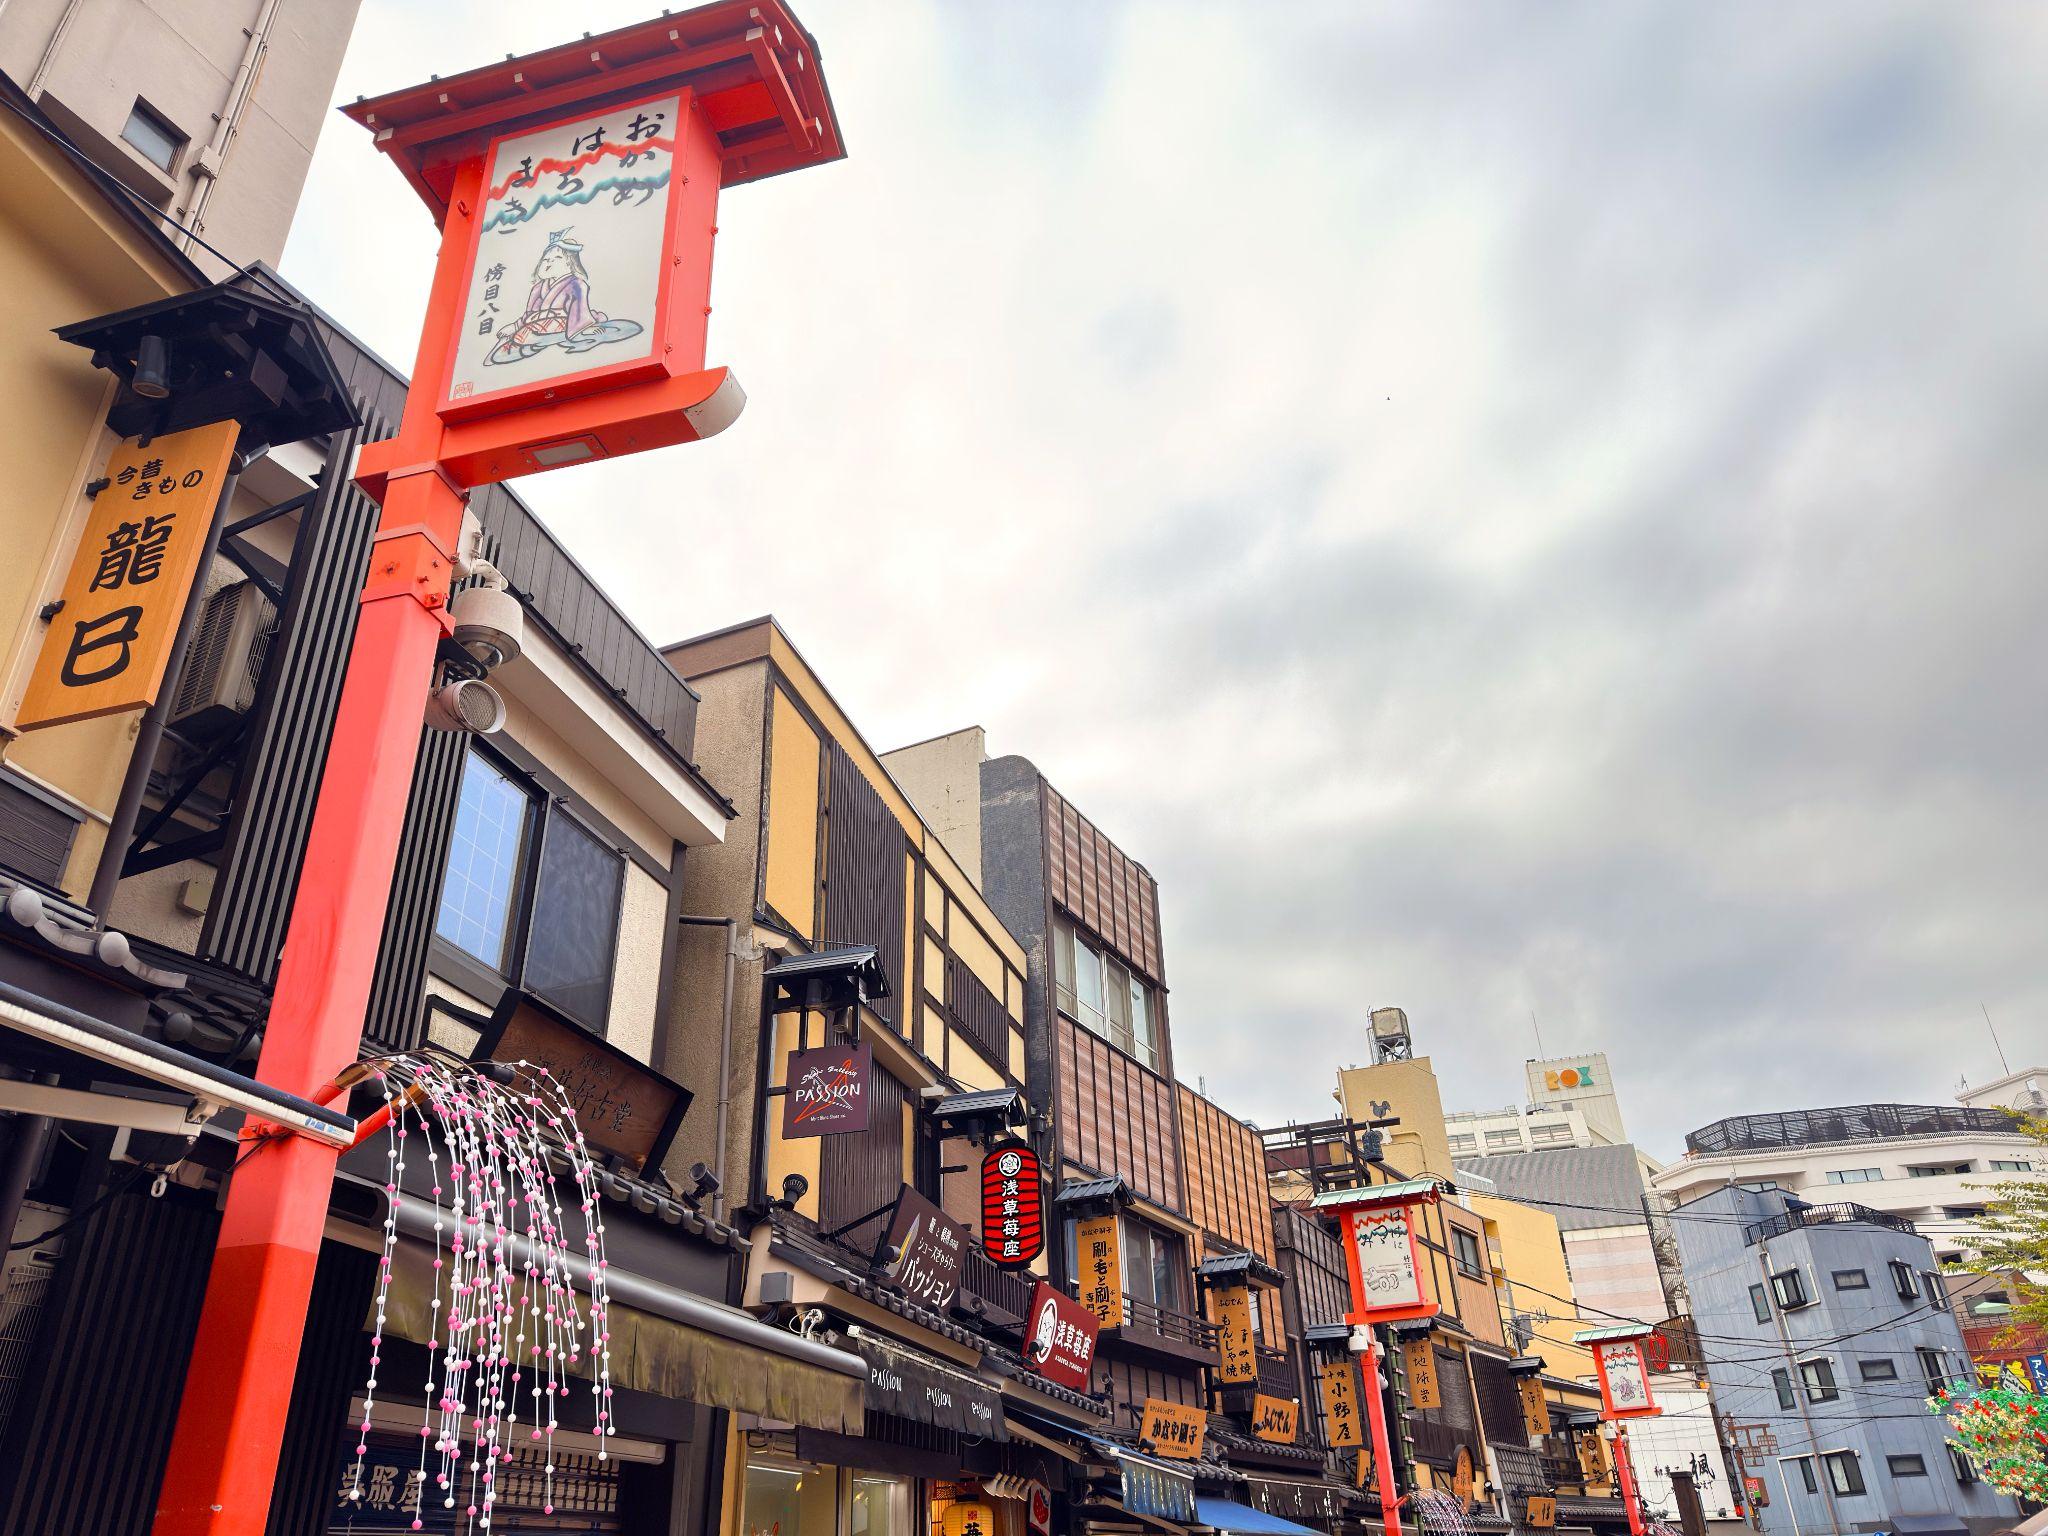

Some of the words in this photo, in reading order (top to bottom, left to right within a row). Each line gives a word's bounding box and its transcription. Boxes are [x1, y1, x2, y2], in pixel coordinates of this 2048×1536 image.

[116, 458, 164, 485] 今昔
[131, 469, 204, 501] きもの
[794, 1082, 861, 1103] PASSION
[1544, 1066, 1595, 1091] ROX
[1001, 1179, 1021, 1257] 浅草苺座
[900, 1256, 956, 1308] パッション
[1092, 1240, 1111, 1322] 刷毛と刷子
[1221, 1313, 1238, 1378] もんじゃ焼
[871, 1367, 903, 1392] PASSION
[926, 1386, 952, 1408] PASSION
[1331, 1382, 1352, 1441] 小野屋
[1262, 1405, 1291, 1434] ふじでん
[1689, 1452, 1715, 1481] 楓
